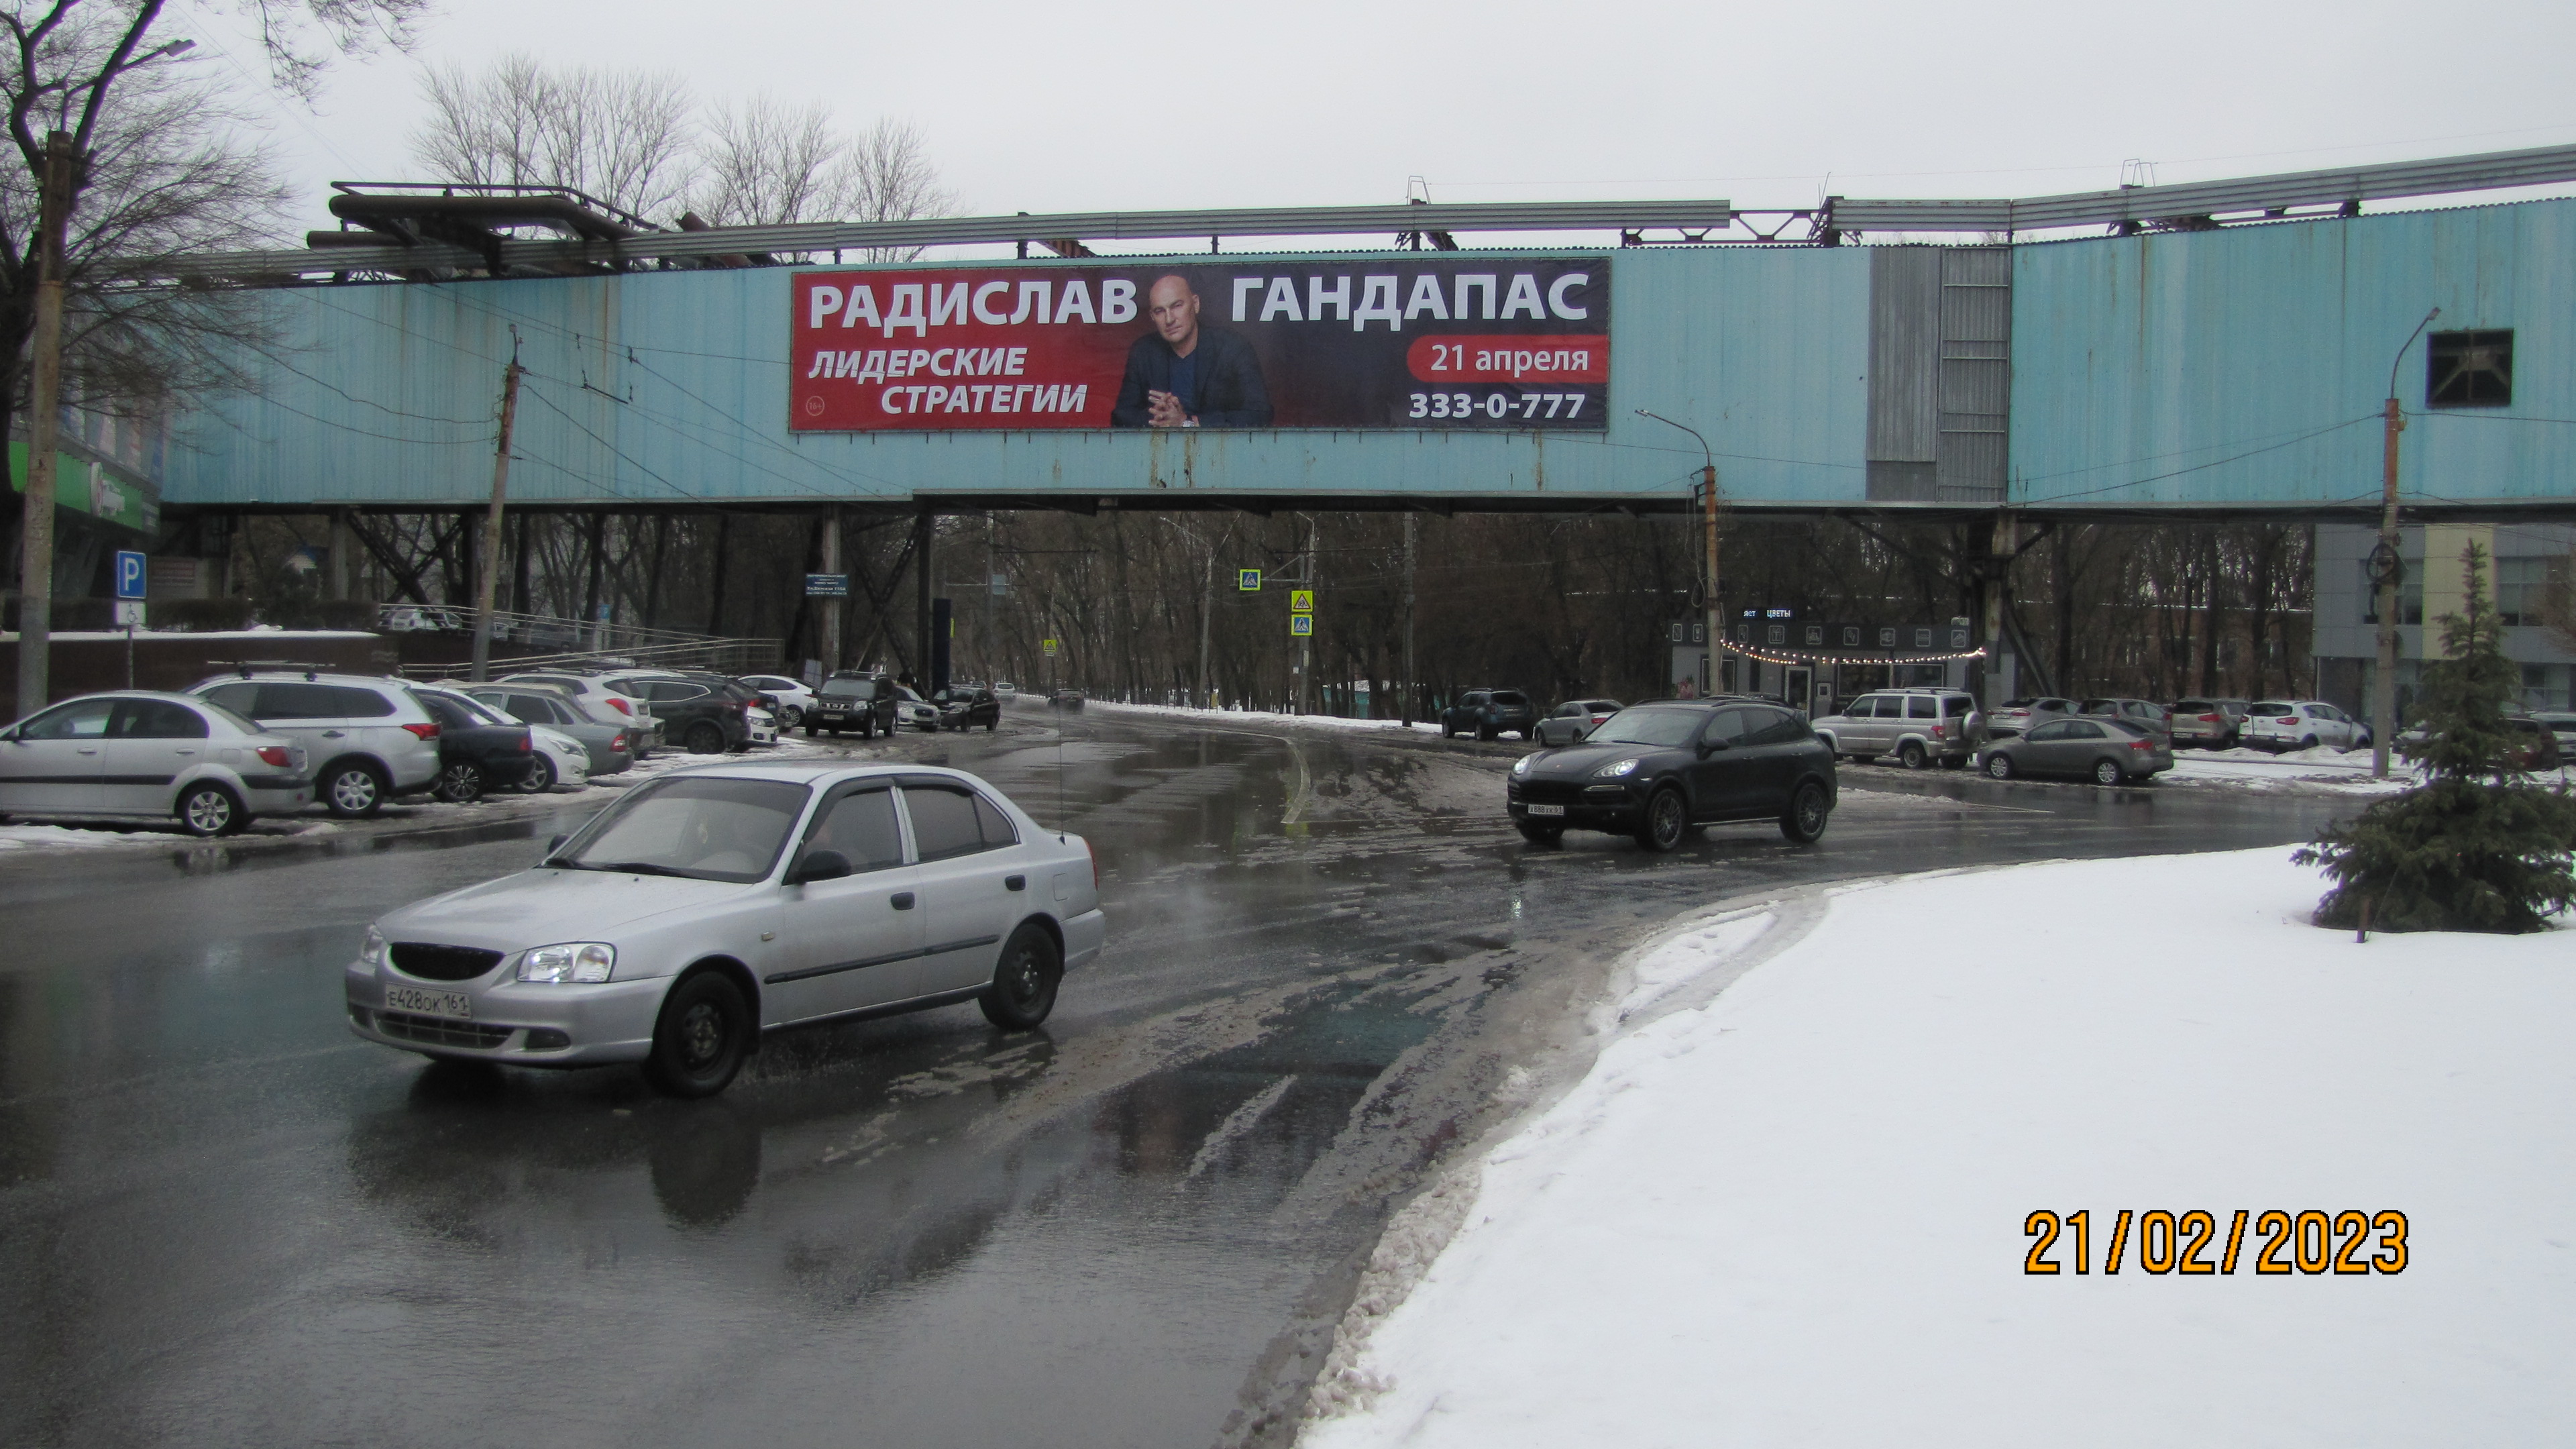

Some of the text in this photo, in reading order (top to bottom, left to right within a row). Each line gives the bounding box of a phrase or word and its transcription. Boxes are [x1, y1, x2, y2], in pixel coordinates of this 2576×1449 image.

[810, 279, 1138, 339] РАДИСЛАВ
[1232, 273, 1590, 332] ГАНДАПАС
[808, 347, 1028, 385] ЛИДЕРСКИЕ
[1431, 344, 1589, 378] 21 апреля
[881, 384, 1088, 414] СТРАТЕГИИ
[1409, 393, 1585, 419] 333-0-777
[1766, 609, 1791, 619] ЦВЕТЫ
